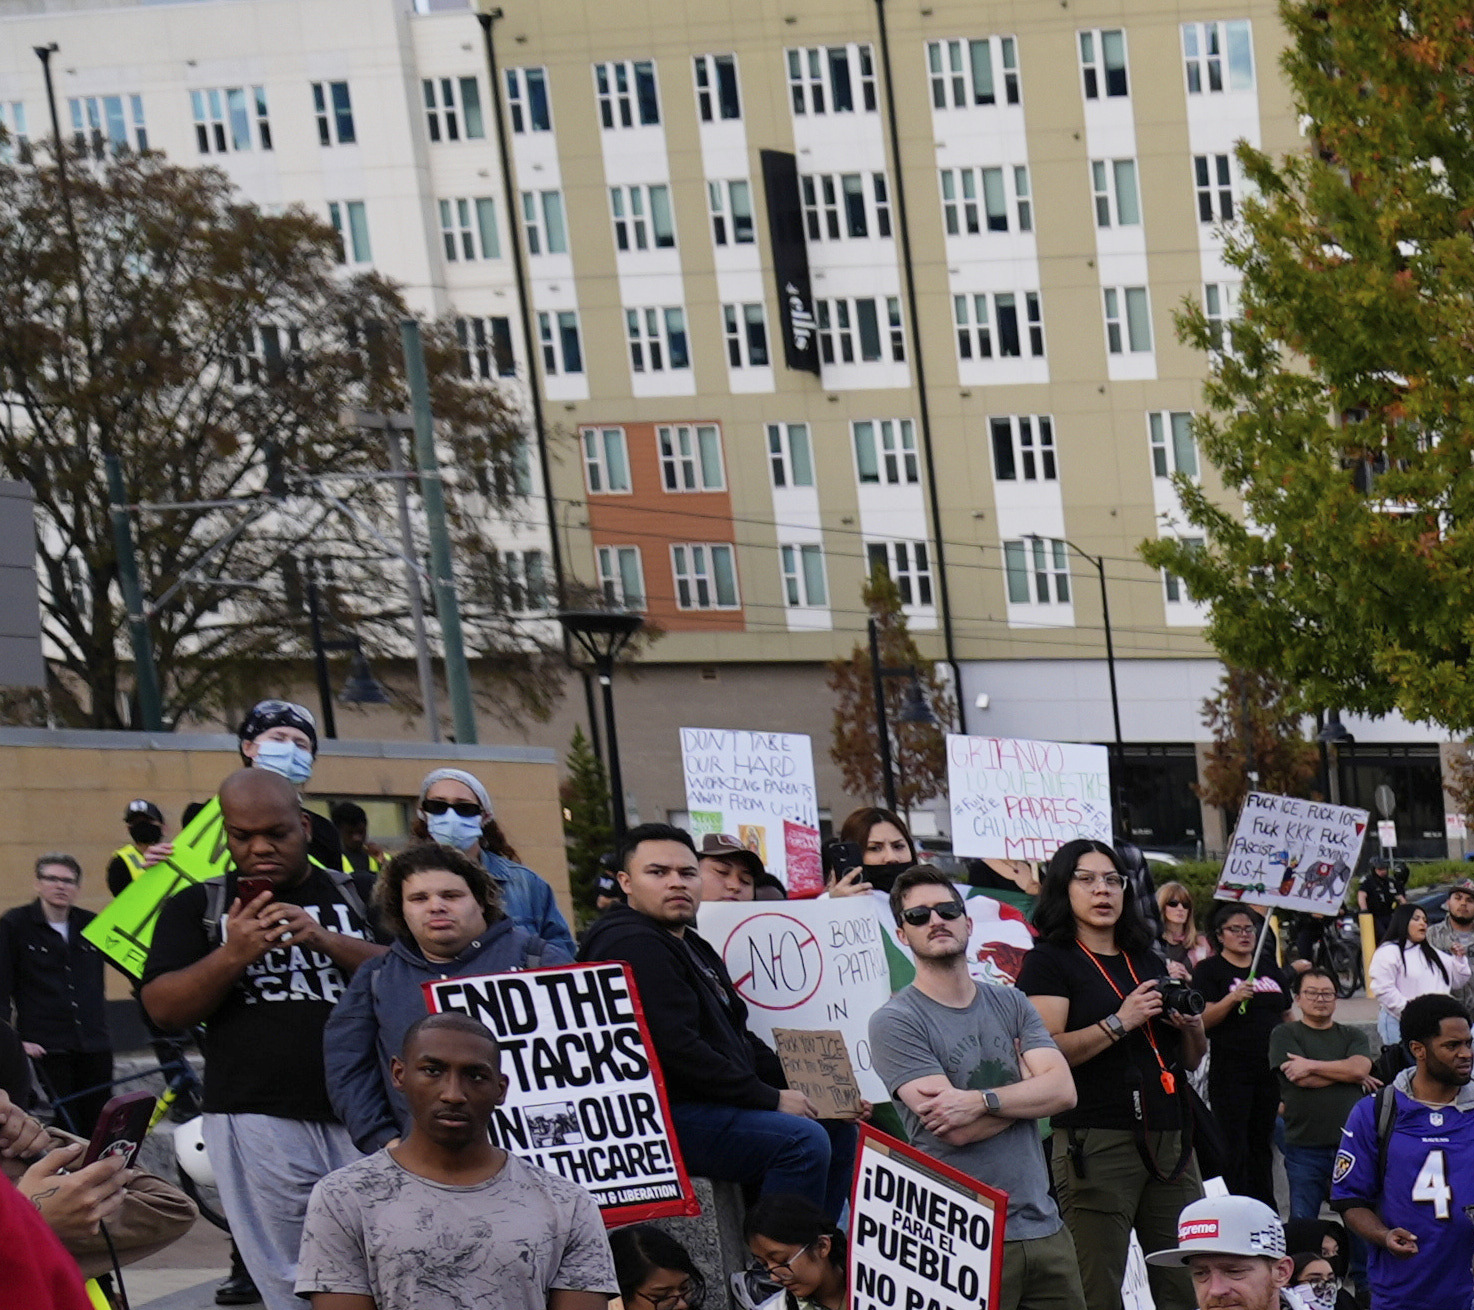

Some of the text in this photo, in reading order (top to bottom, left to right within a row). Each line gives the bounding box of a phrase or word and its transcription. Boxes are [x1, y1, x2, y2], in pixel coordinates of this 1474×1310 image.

[750, 732, 792, 752] TAKE
[686, 756, 795, 777] OUR HARD
[687, 776, 760, 792] WORKING
[729, 794, 765, 811] FROM
[1004, 796, 1082, 824] PADRES
[1247, 794, 1277, 811] FUCK
[747, 930, 807, 992] NO
[536, 967, 637, 1030] THE
[827, 998, 848, 1022] IN
[578, 1092, 662, 1142] OUR
[619, 1184, 678, 1203] LIBERATION
[1411, 1150, 1451, 1219] 4
[864, 1164, 991, 1251] ¡DINERO
[892, 1209, 958, 1257] PARA EL
[856, 1261, 896, 1307] NO
